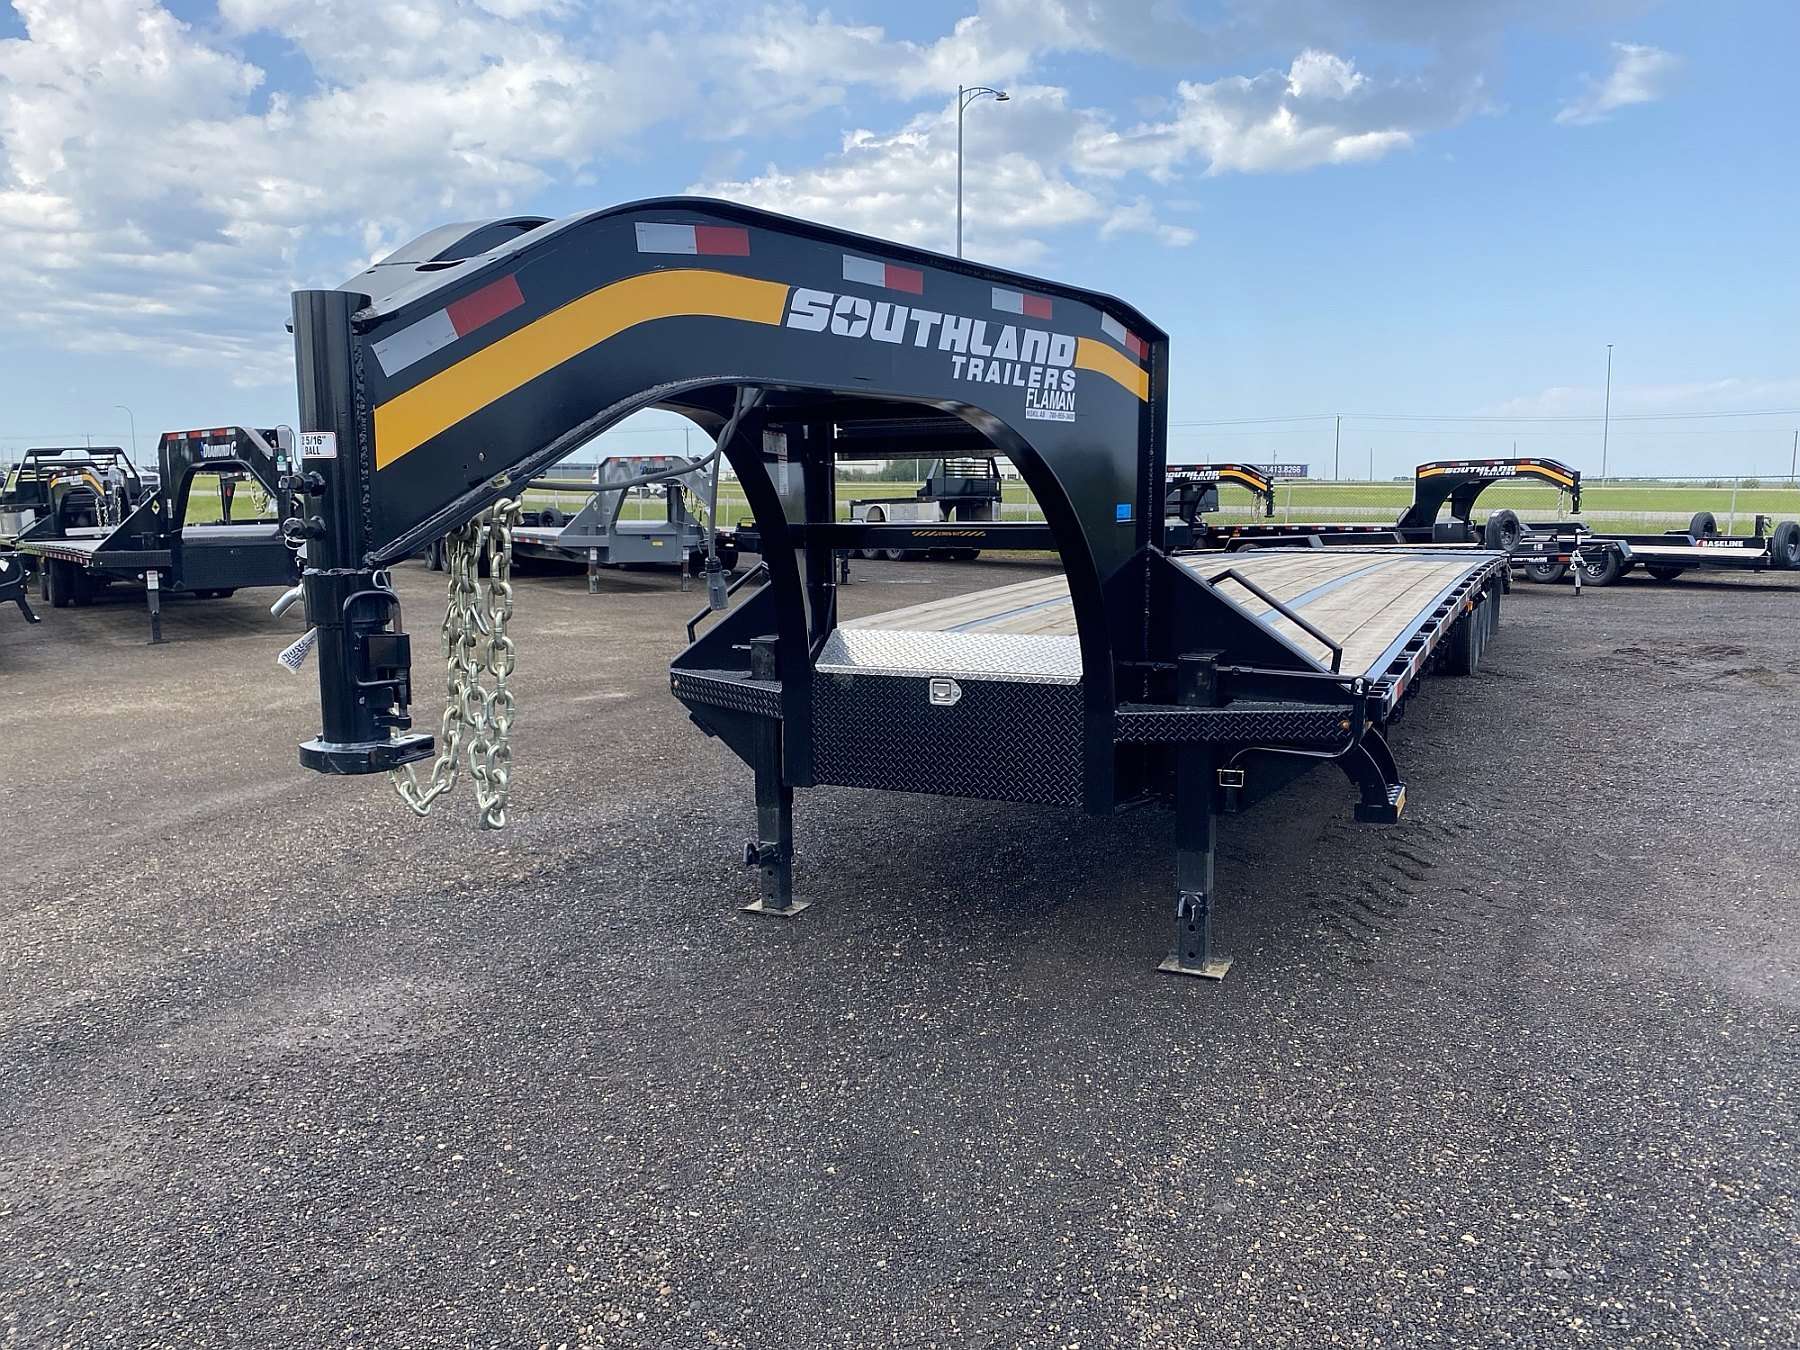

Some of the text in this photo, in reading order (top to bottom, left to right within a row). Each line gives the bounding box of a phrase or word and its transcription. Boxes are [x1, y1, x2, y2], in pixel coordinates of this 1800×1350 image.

[786, 287, 1076, 368] SOUTHLAND
[951, 355, 1076, 391] TRAILERS
[1025, 387, 1076, 411] FLAMAN
[230, 440, 237, 457] C
[304, 445, 321, 456] BALL
[1444, 465, 1517, 474] SOUTHLAND
[1702, 540, 1744, 548] BASELINE
